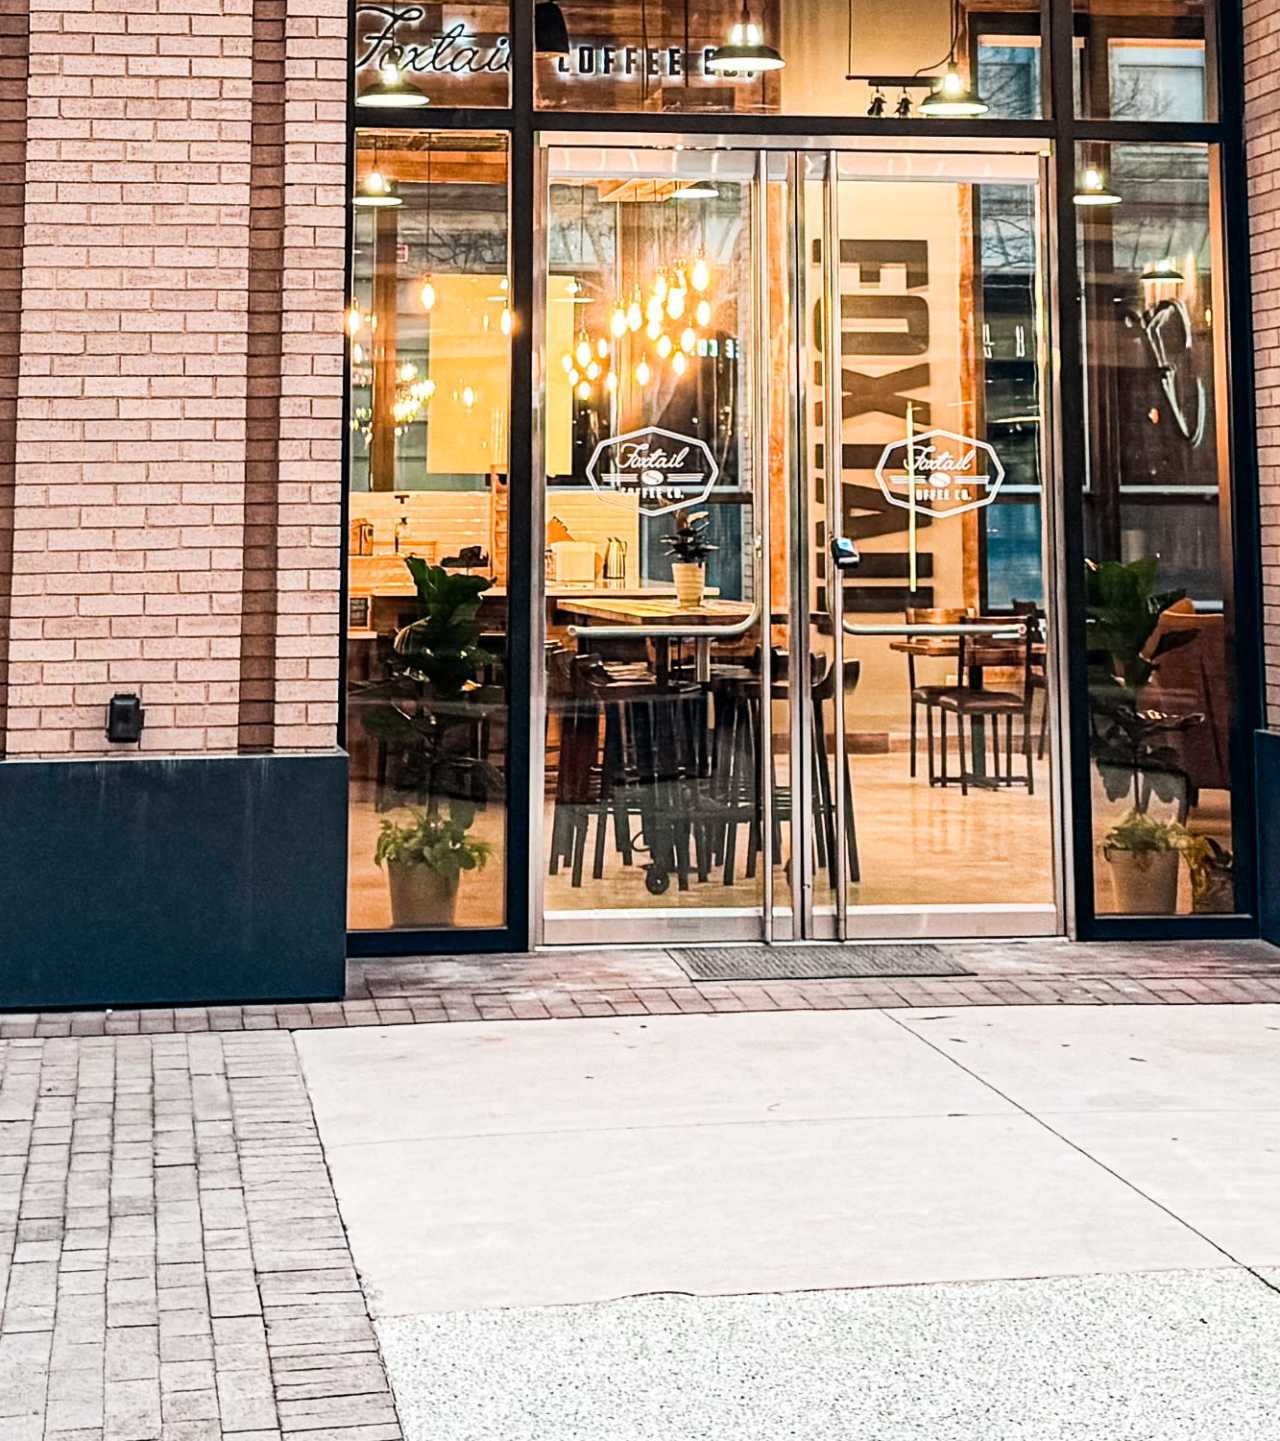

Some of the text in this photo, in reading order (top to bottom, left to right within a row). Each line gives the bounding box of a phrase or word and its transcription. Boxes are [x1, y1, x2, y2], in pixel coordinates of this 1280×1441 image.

[356, 6, 510, 72] Foxtai
[616, 442, 690, 469] Foxtail
[904, 445, 977, 471] Foxtail
